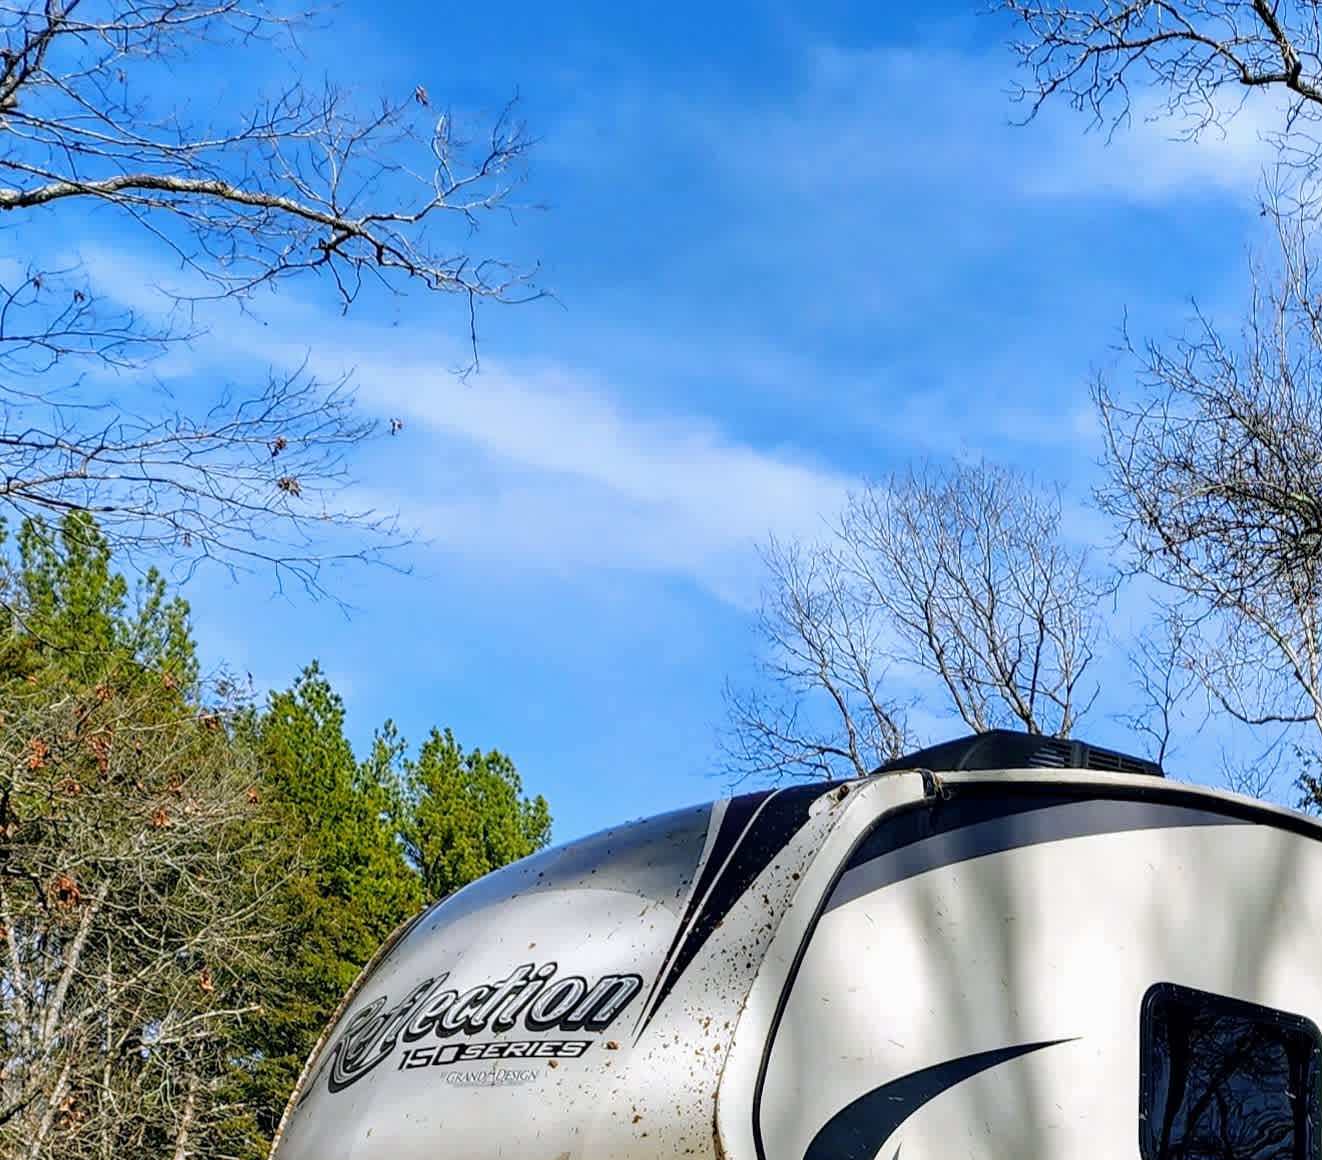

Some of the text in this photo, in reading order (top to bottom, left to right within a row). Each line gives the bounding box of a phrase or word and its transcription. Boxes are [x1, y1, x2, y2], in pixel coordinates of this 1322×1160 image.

[304, 961, 644, 1104] Reflection
[399, 1041, 590, 1071] 150 SERIES
[446, 1070, 488, 1084] GRAND
